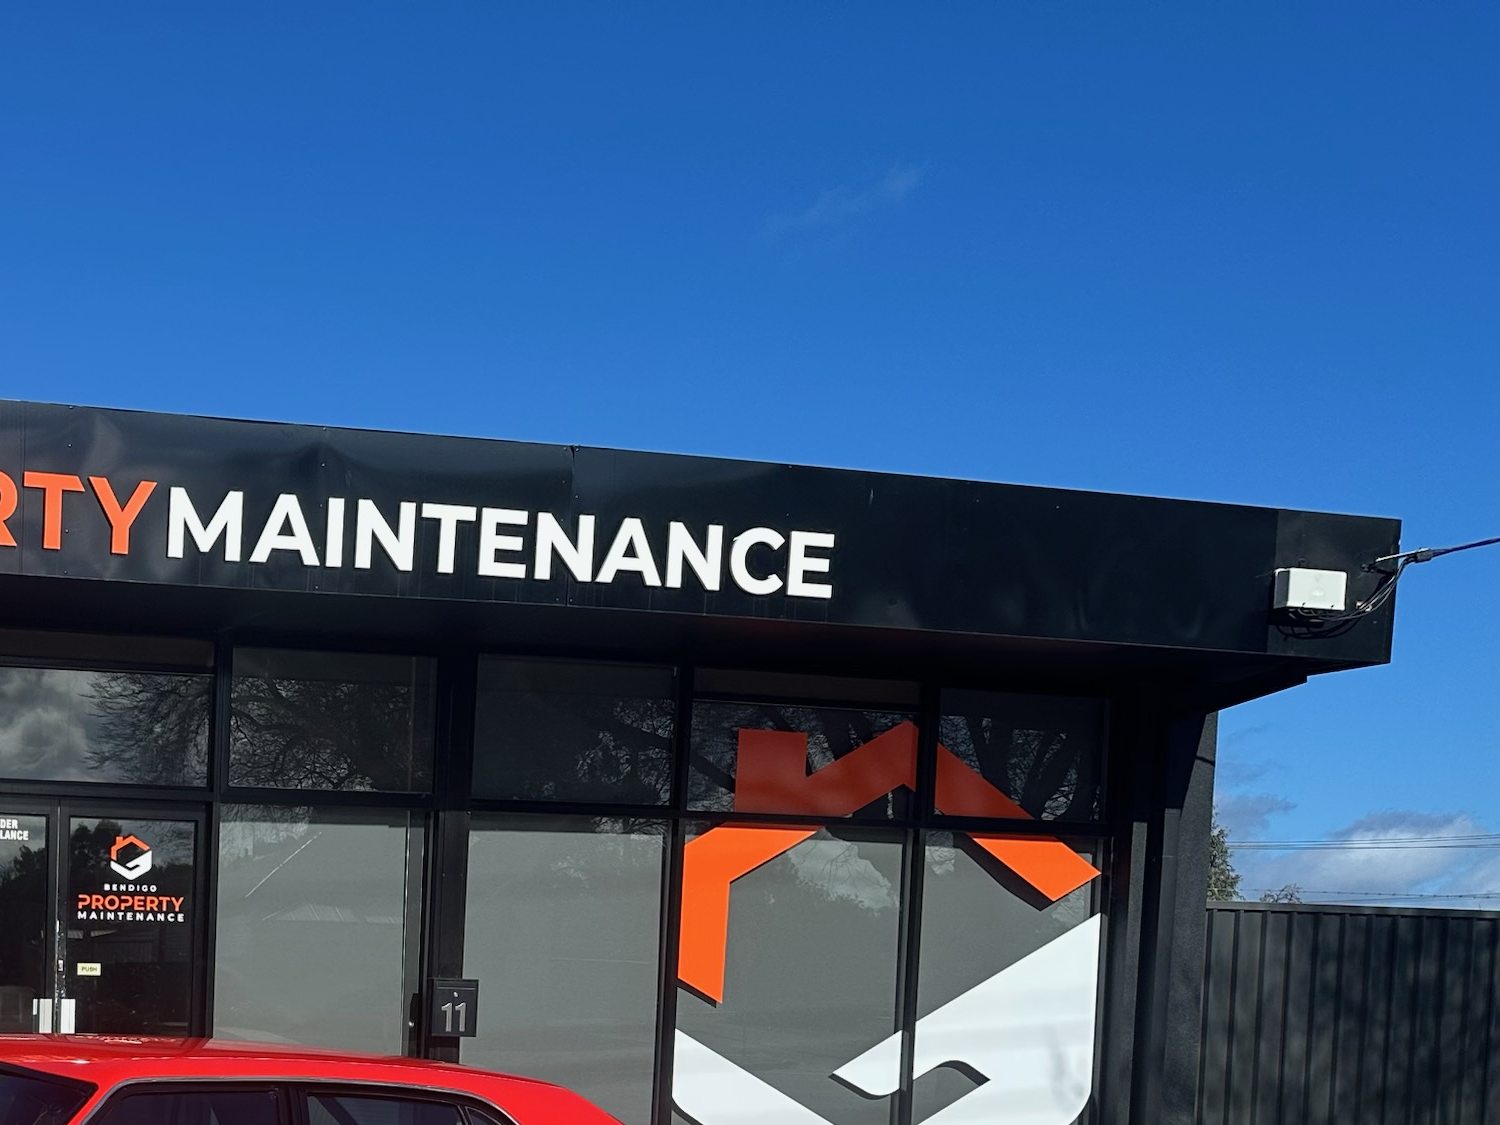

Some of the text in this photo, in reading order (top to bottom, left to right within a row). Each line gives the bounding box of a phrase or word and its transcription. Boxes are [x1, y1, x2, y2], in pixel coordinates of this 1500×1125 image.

[166, 486, 836, 599] MAINTENANCE
[103, 883, 158, 893] BENDIGO
[77, 894, 185, 912] PROPERTY
[77, 910, 186, 923] MAINTENANCE
[441, 1002, 467, 1032] 11
